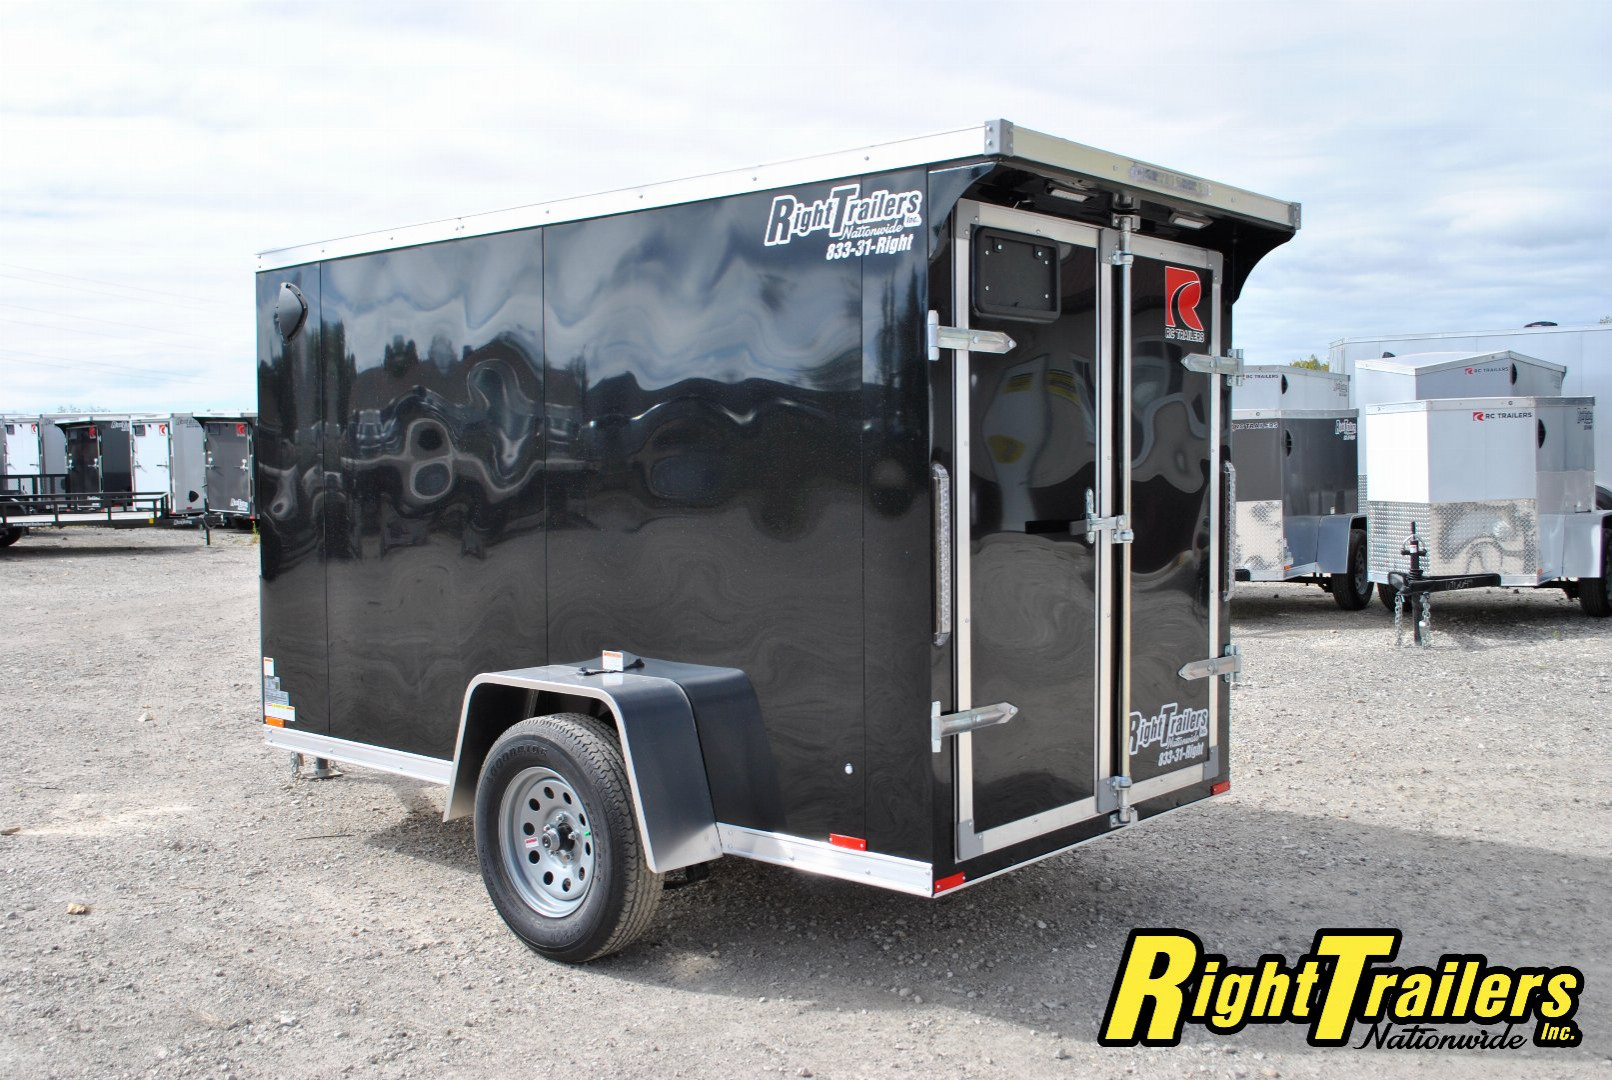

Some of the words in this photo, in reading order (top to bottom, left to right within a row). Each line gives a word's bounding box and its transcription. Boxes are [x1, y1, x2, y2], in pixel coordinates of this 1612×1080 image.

[839, 221, 904, 240] Nationwide
[826, 234, 914, 260] 833-31-Right
[1165, 327, 1176, 339] RC
[1176, 328, 1205, 343] TRAILERS
[1158, 742, 1204, 766] 833-31-Right
